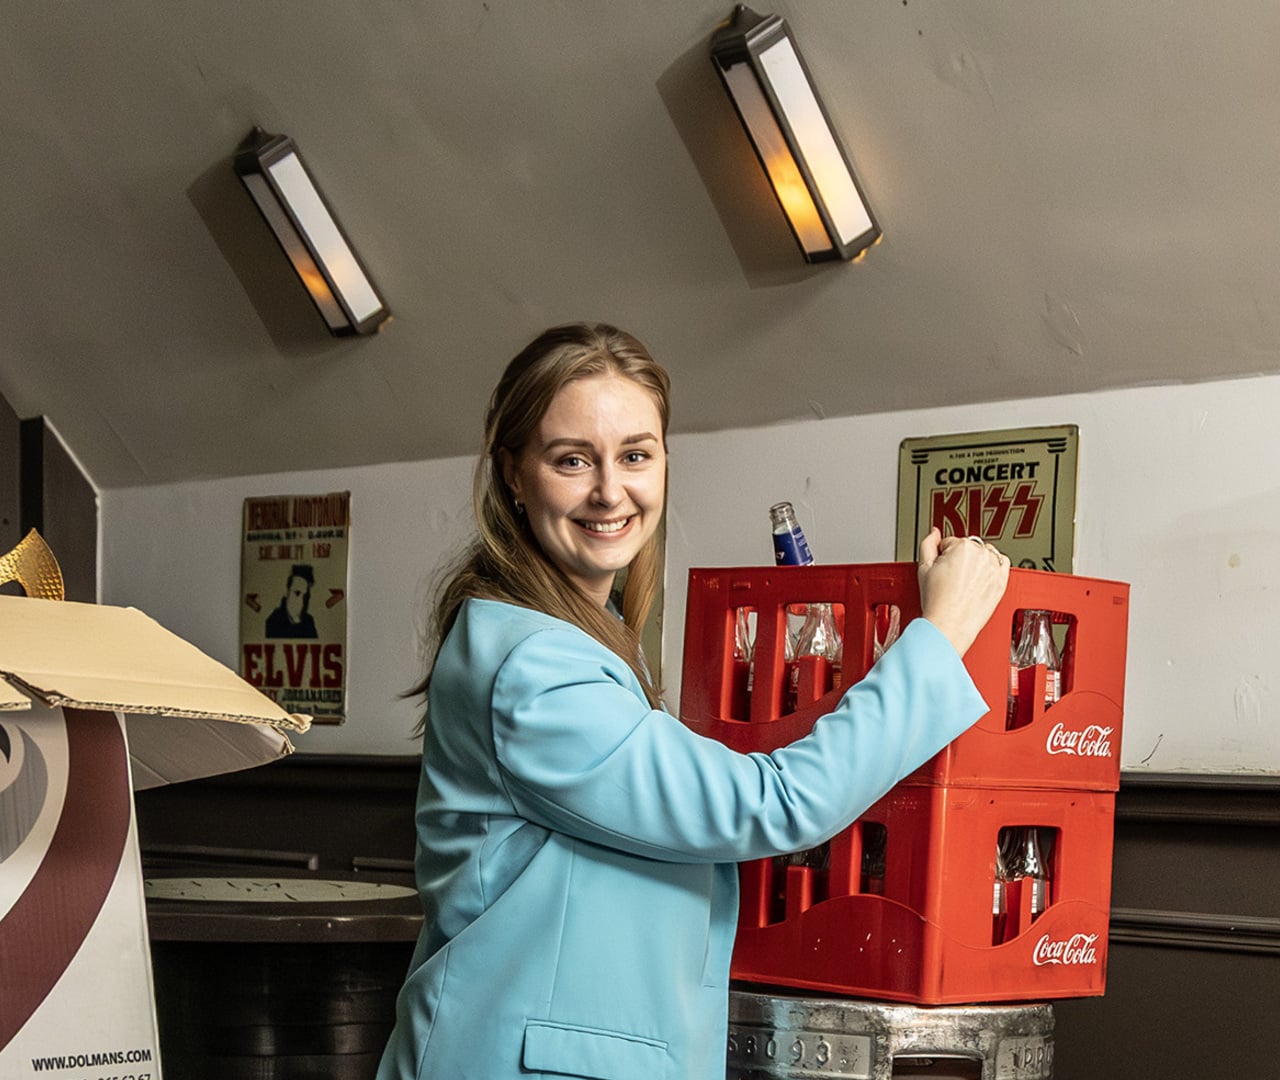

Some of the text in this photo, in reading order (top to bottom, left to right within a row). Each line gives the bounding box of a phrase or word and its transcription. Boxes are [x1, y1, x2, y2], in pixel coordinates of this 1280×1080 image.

[935, 461, 1040, 485] CONCERT
[930, 481, 1046, 540] KISS
[243, 643, 343, 689] ELVIS
[1046, 722, 1114, 758] Coca-Cola
[1032, 933, 1099, 966] Coca-Cola
[32, 1049, 152, 1071] WWW.DOLMANS.COM
